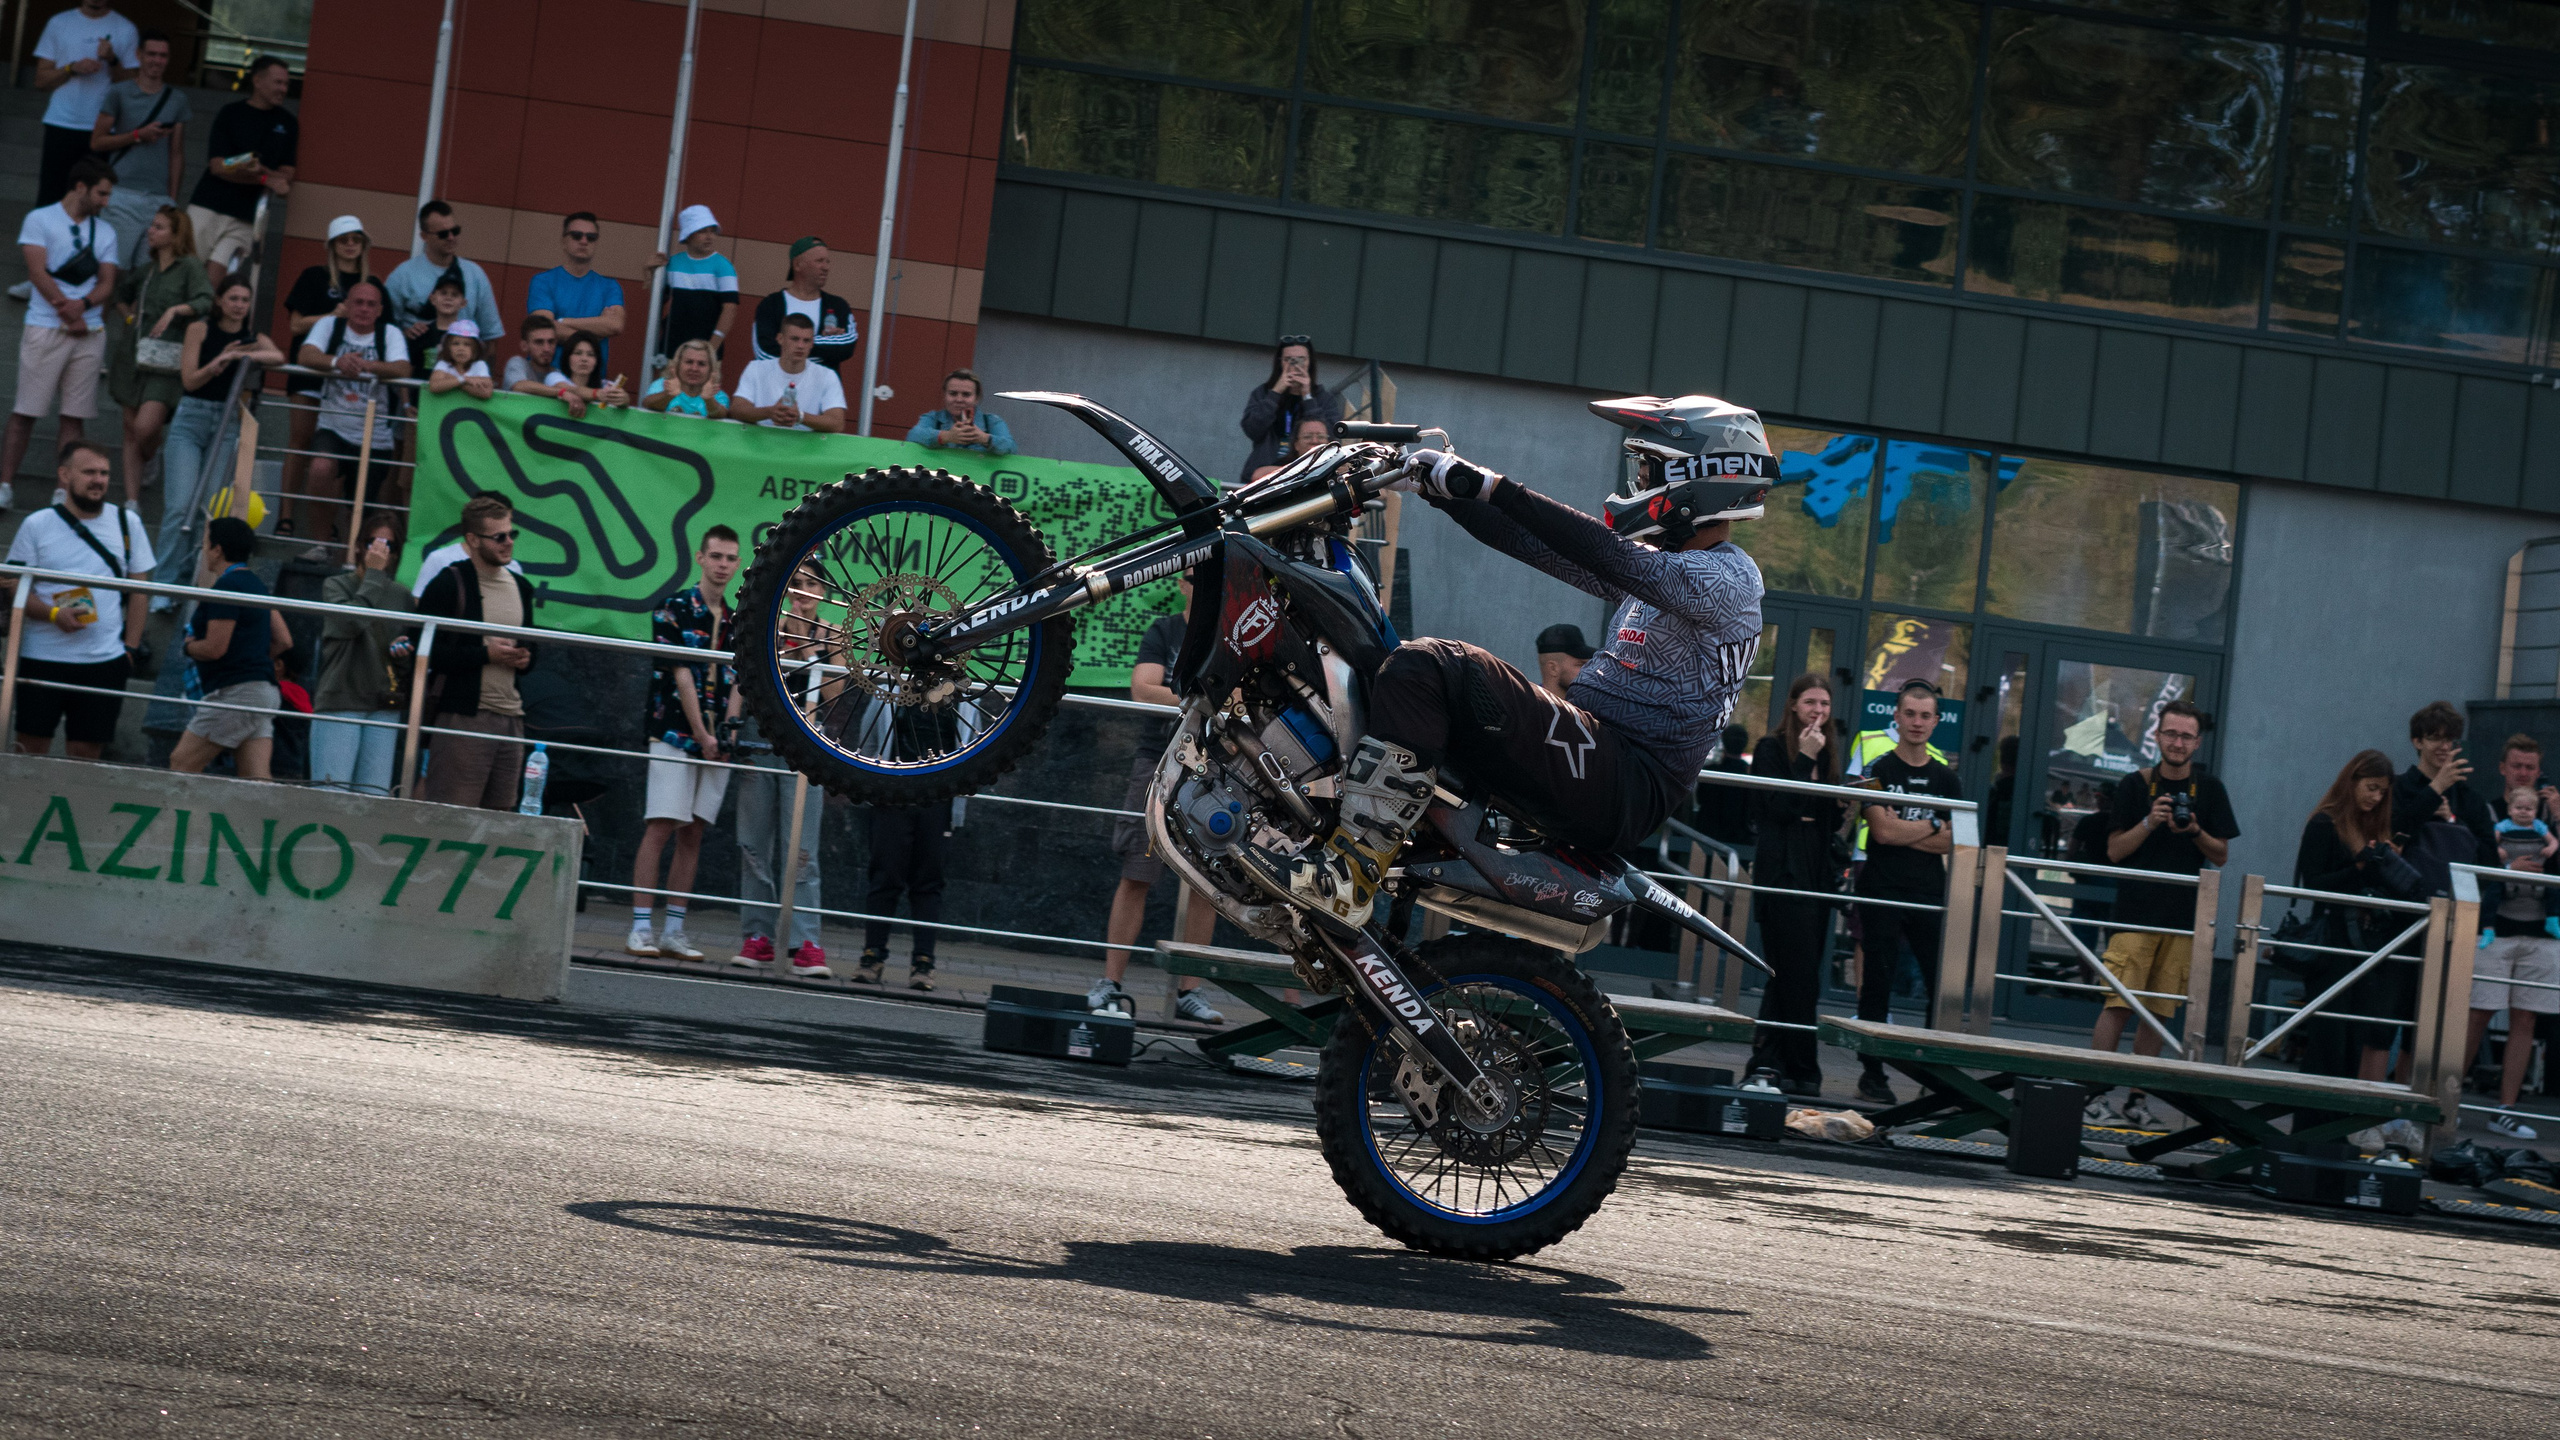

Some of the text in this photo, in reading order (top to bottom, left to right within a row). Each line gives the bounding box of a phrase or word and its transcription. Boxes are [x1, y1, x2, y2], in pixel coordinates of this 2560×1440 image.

[1127, 433, 1184, 483] FMX.RU
[1123, 544, 1214, 590] ВОЛЧИЙ ДУХ
[1618, 628, 1646, 645] ENDA
[0, 795, 546, 920] AZINO 777
[1644, 884, 1695, 919] FMX.RU
[1355, 953, 1435, 1036] KENDA
